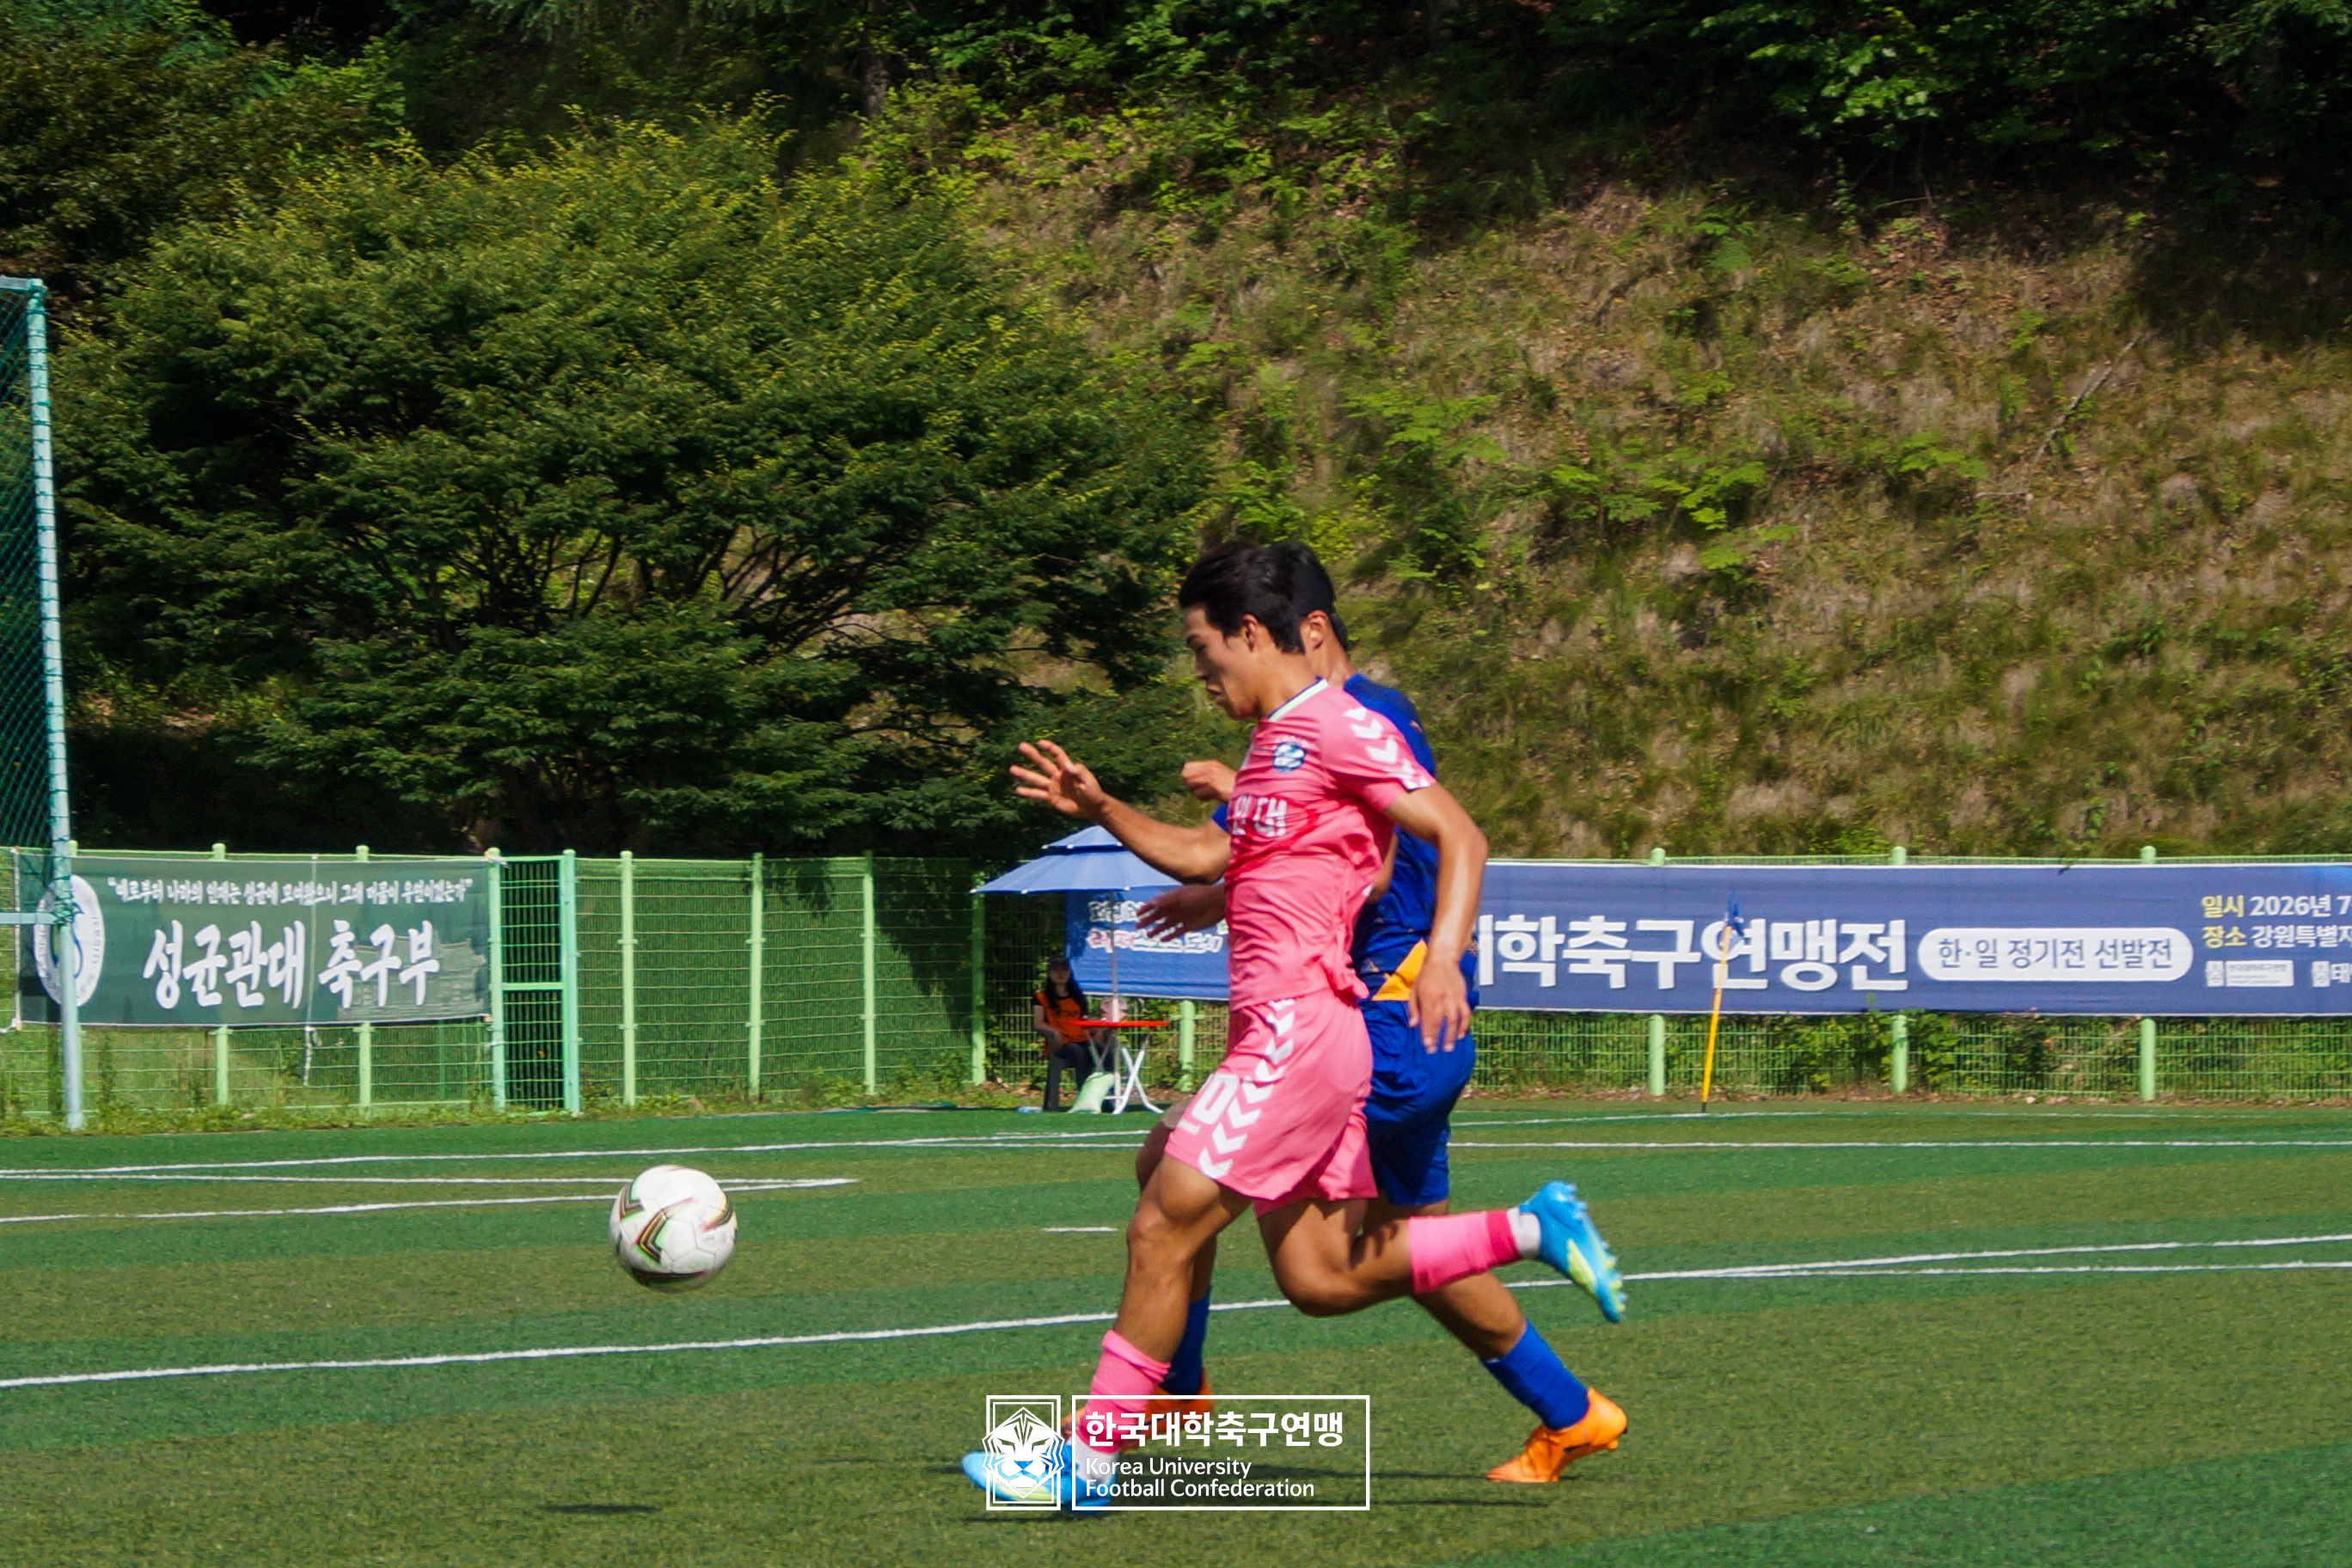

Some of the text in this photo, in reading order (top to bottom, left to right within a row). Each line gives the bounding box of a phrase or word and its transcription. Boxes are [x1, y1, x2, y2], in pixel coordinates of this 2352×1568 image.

[167, 879, 204, 904] 나라의
[2200, 894, 2245, 918] 일시
[2249, 894, 2331, 917] 2026년
[2202, 925, 2248, 949] 장소
[143, 919, 306, 1009] 성균관대
[318, 919, 441, 1009] 축구부
[2008, 939, 2086, 969] 정기전
[2094, 938, 2173, 969] 선발전
